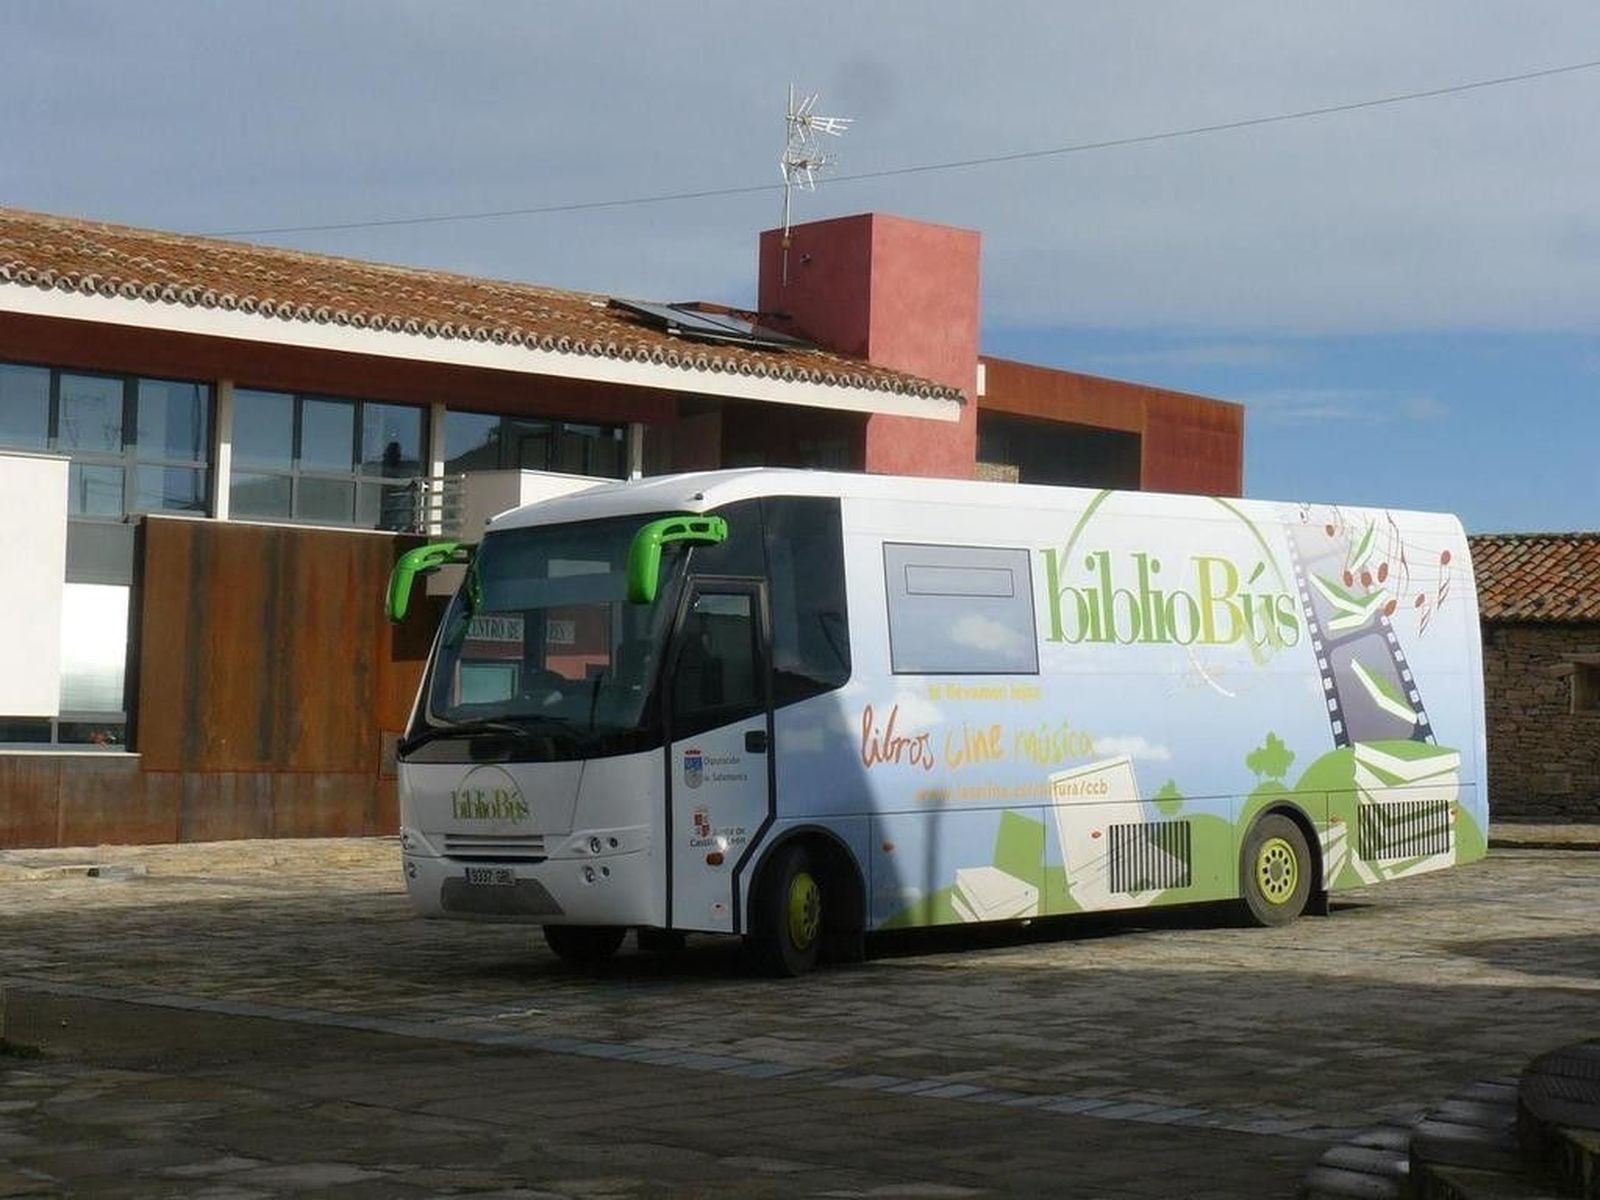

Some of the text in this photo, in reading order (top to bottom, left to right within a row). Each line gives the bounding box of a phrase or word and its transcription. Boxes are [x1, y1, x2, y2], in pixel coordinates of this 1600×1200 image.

[1039, 548, 1300, 648] biblioBús
[862, 704, 934, 771] libros
[944, 722, 1005, 769] cine
